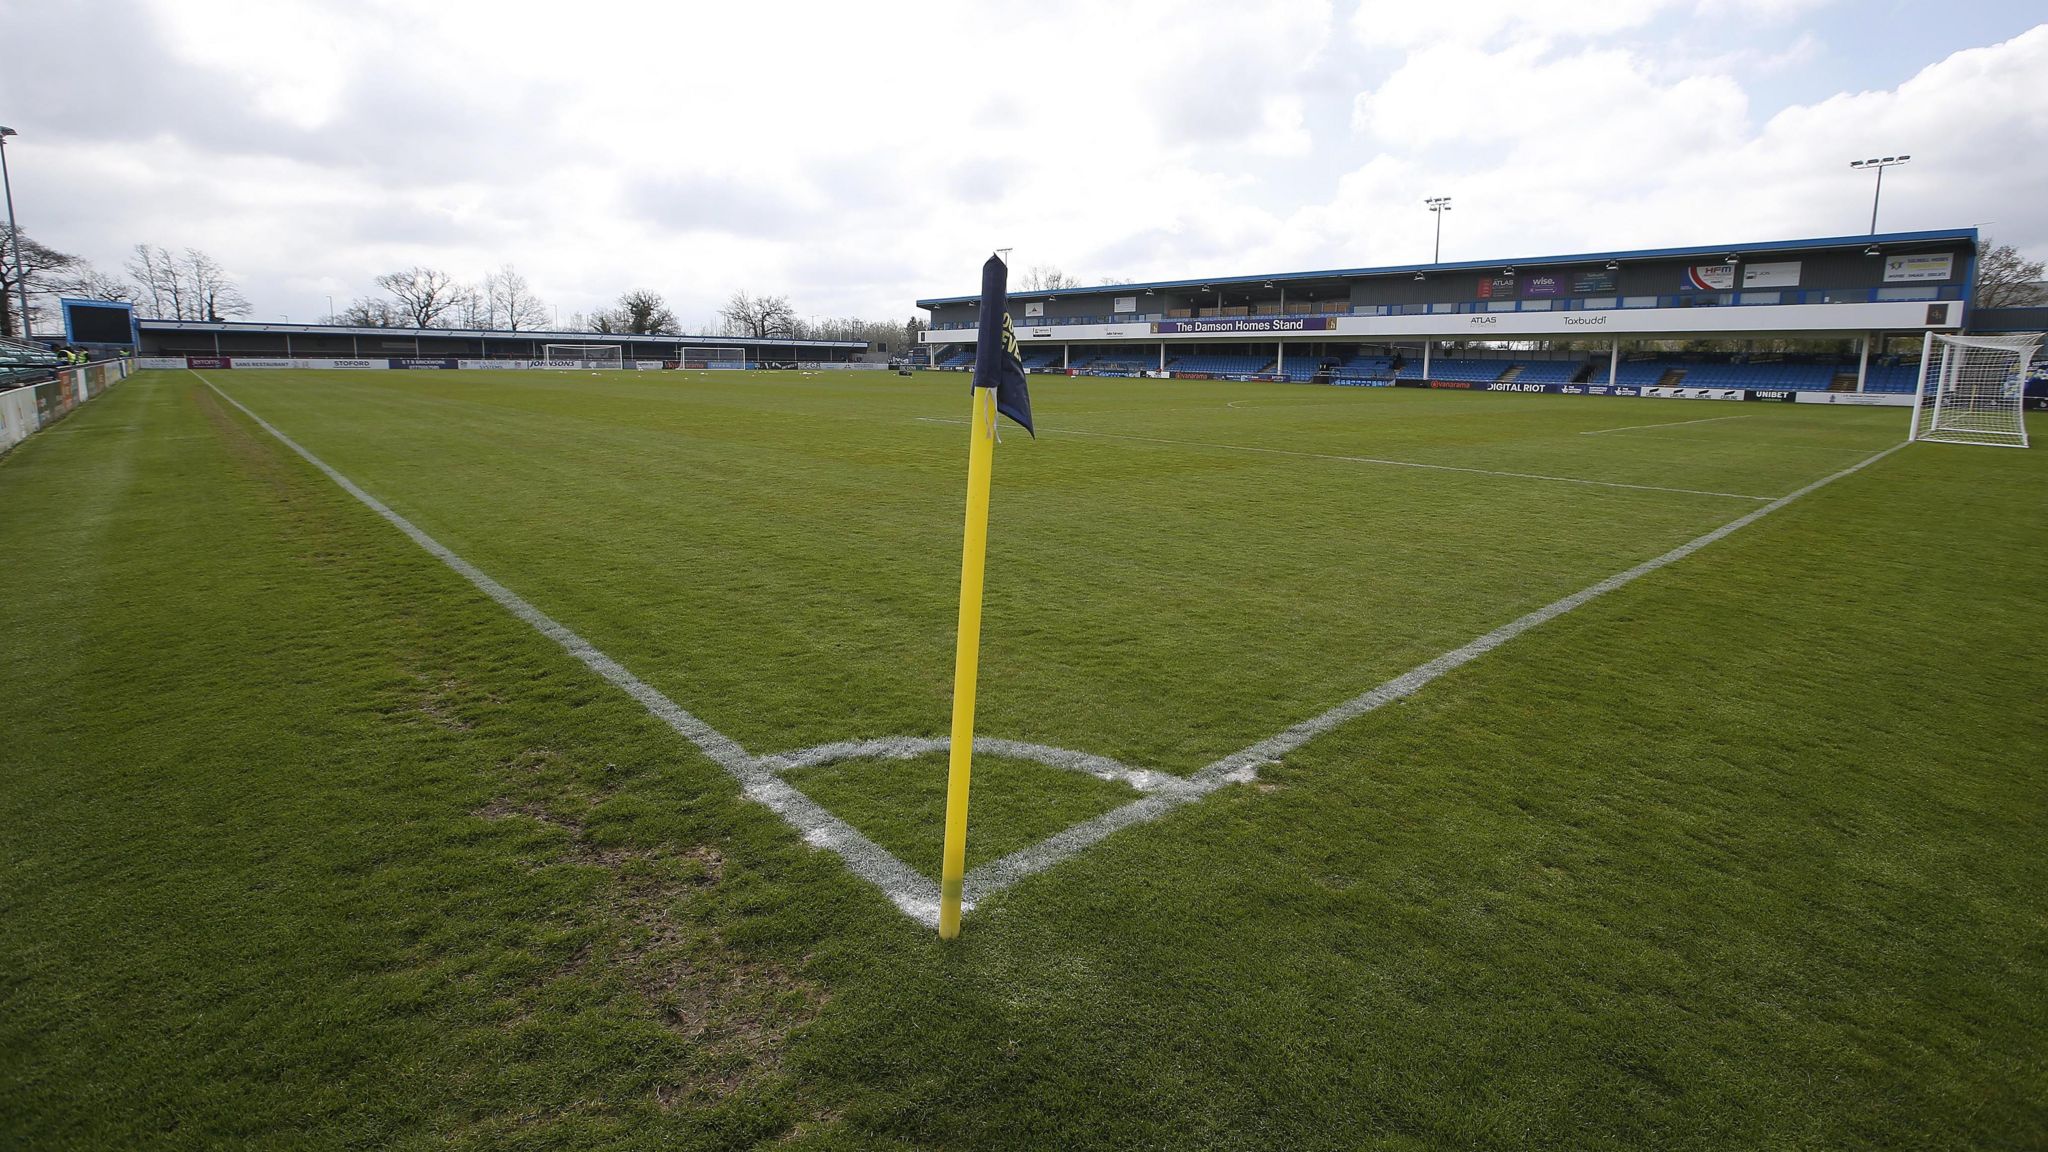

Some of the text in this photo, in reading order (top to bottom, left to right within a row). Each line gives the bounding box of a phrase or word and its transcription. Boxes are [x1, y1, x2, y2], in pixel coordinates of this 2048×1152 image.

[1471, 316, 1497, 324] ATLAS
[1563, 316, 1607, 325] Taxbuddi
[1176, 319, 1303, 333] The Damson Homes Stand
[1486, 383, 1546, 392] DIGITAL RIOT
[1756, 391, 1789, 399] UNIBET
